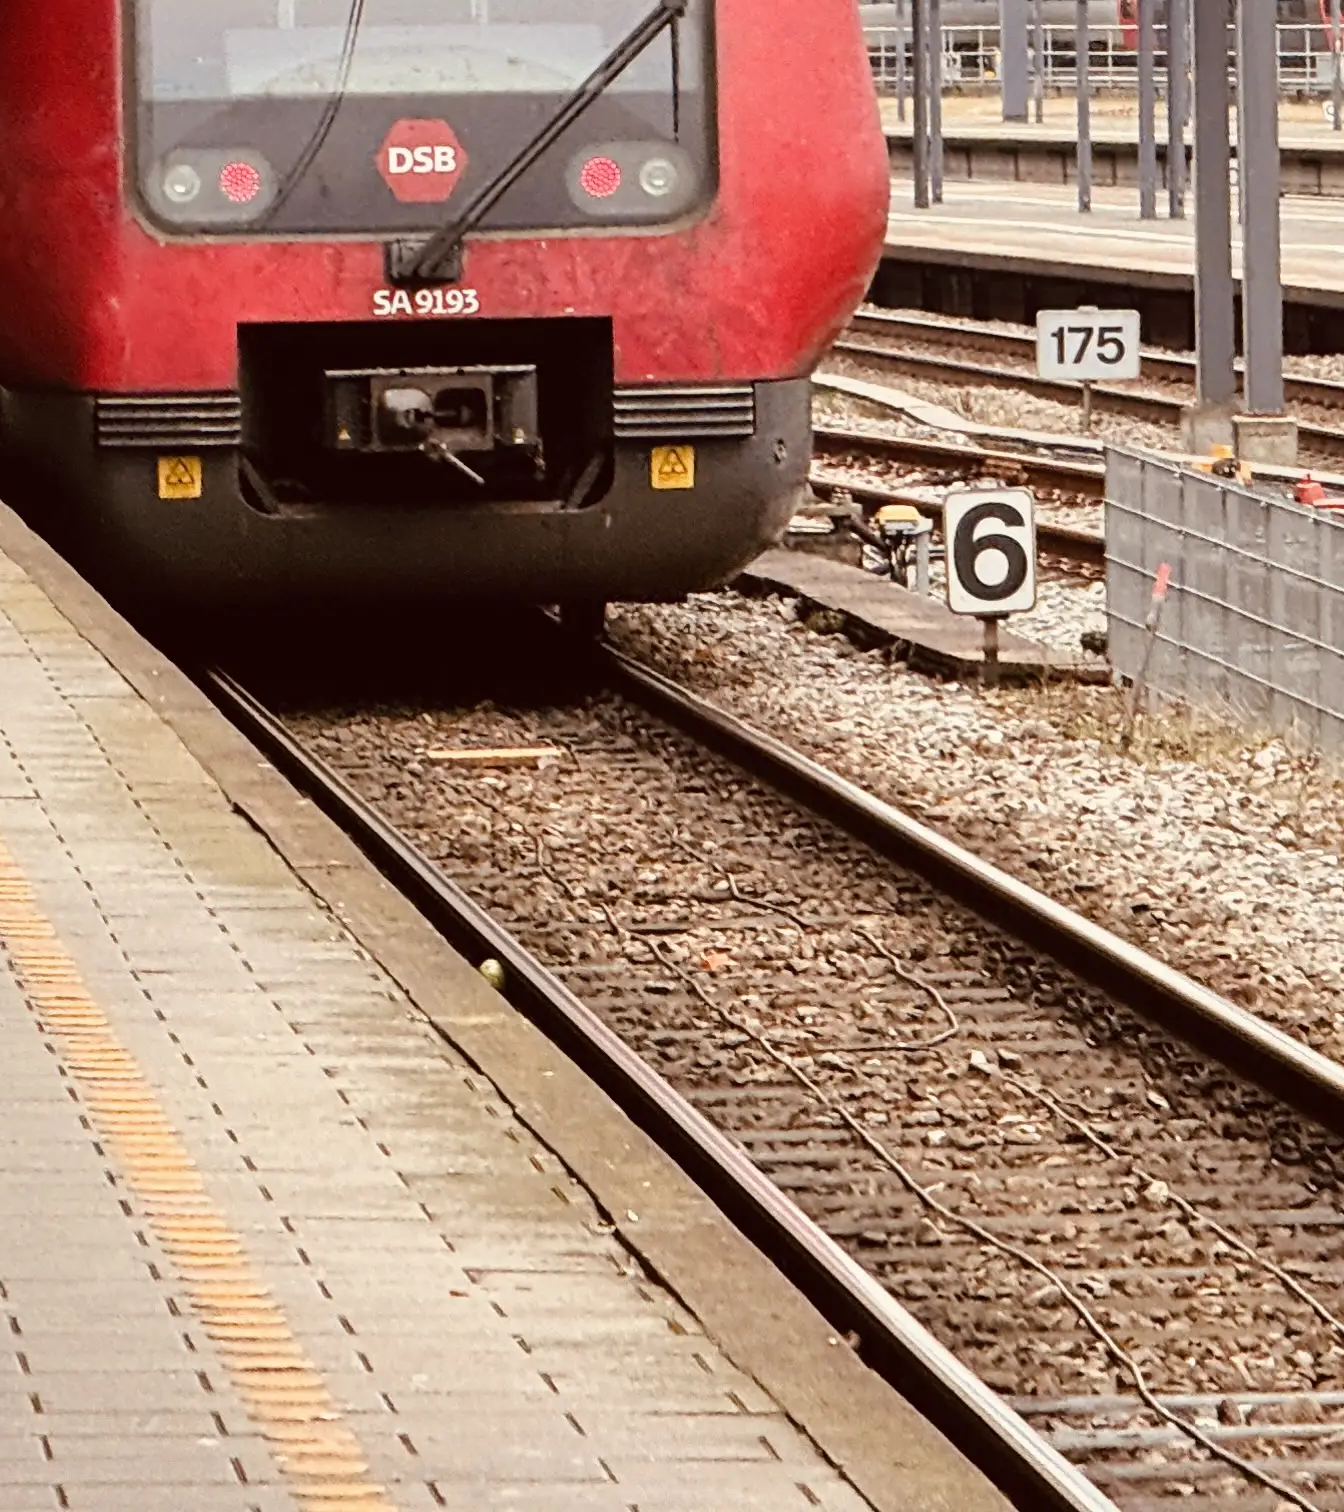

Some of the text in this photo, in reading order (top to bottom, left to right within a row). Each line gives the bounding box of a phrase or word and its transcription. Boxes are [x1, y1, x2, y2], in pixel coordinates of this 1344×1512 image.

[388, 145, 456, 174] DSB
[373, 289, 480, 315] SA 9193
[1051, 326, 1126, 365] 175
[955, 502, 1028, 601] 6
